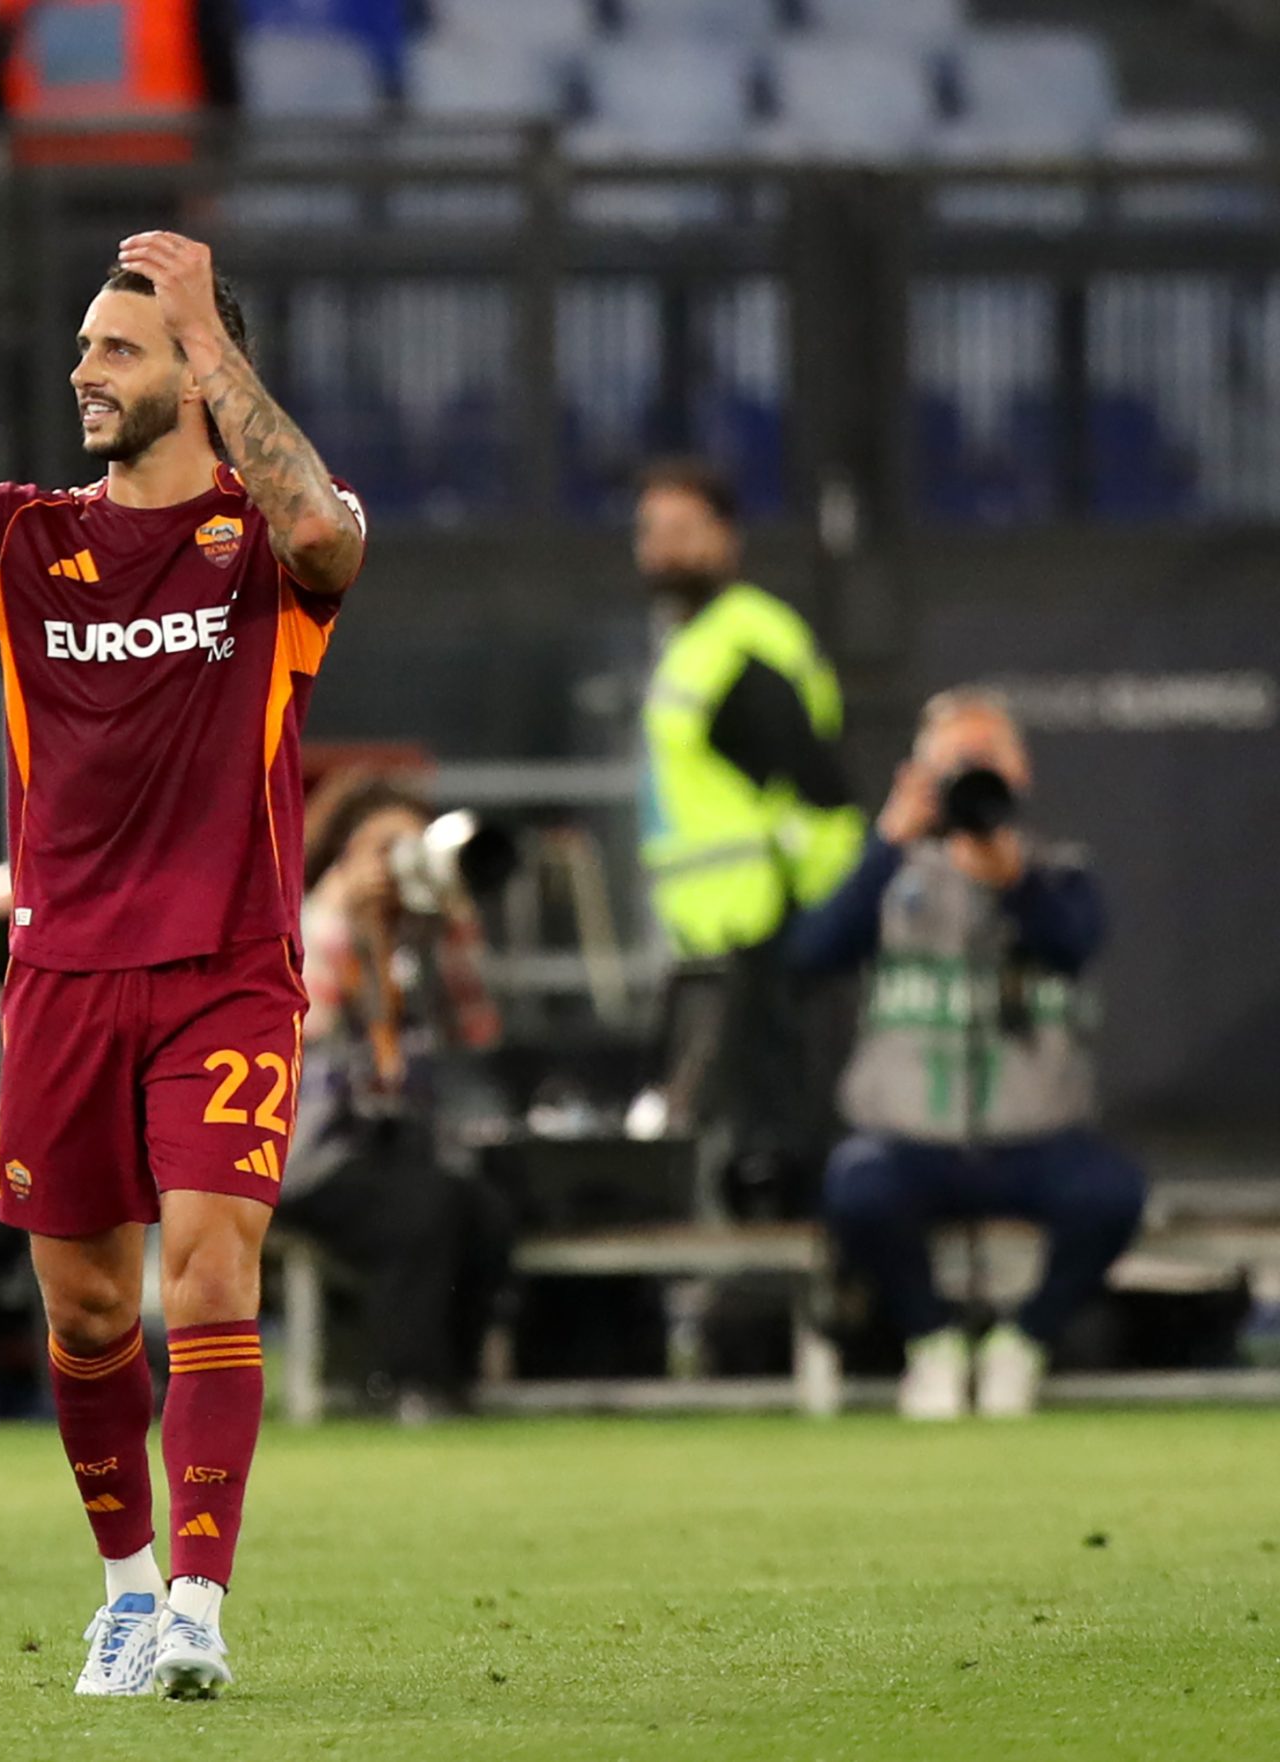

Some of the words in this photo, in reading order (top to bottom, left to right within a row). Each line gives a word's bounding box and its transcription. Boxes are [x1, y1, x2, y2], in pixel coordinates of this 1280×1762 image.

[44, 590, 238, 662] EUROBE
[203, 1049, 288, 1136] 22
[183, 1465, 227, 1485] ASR
